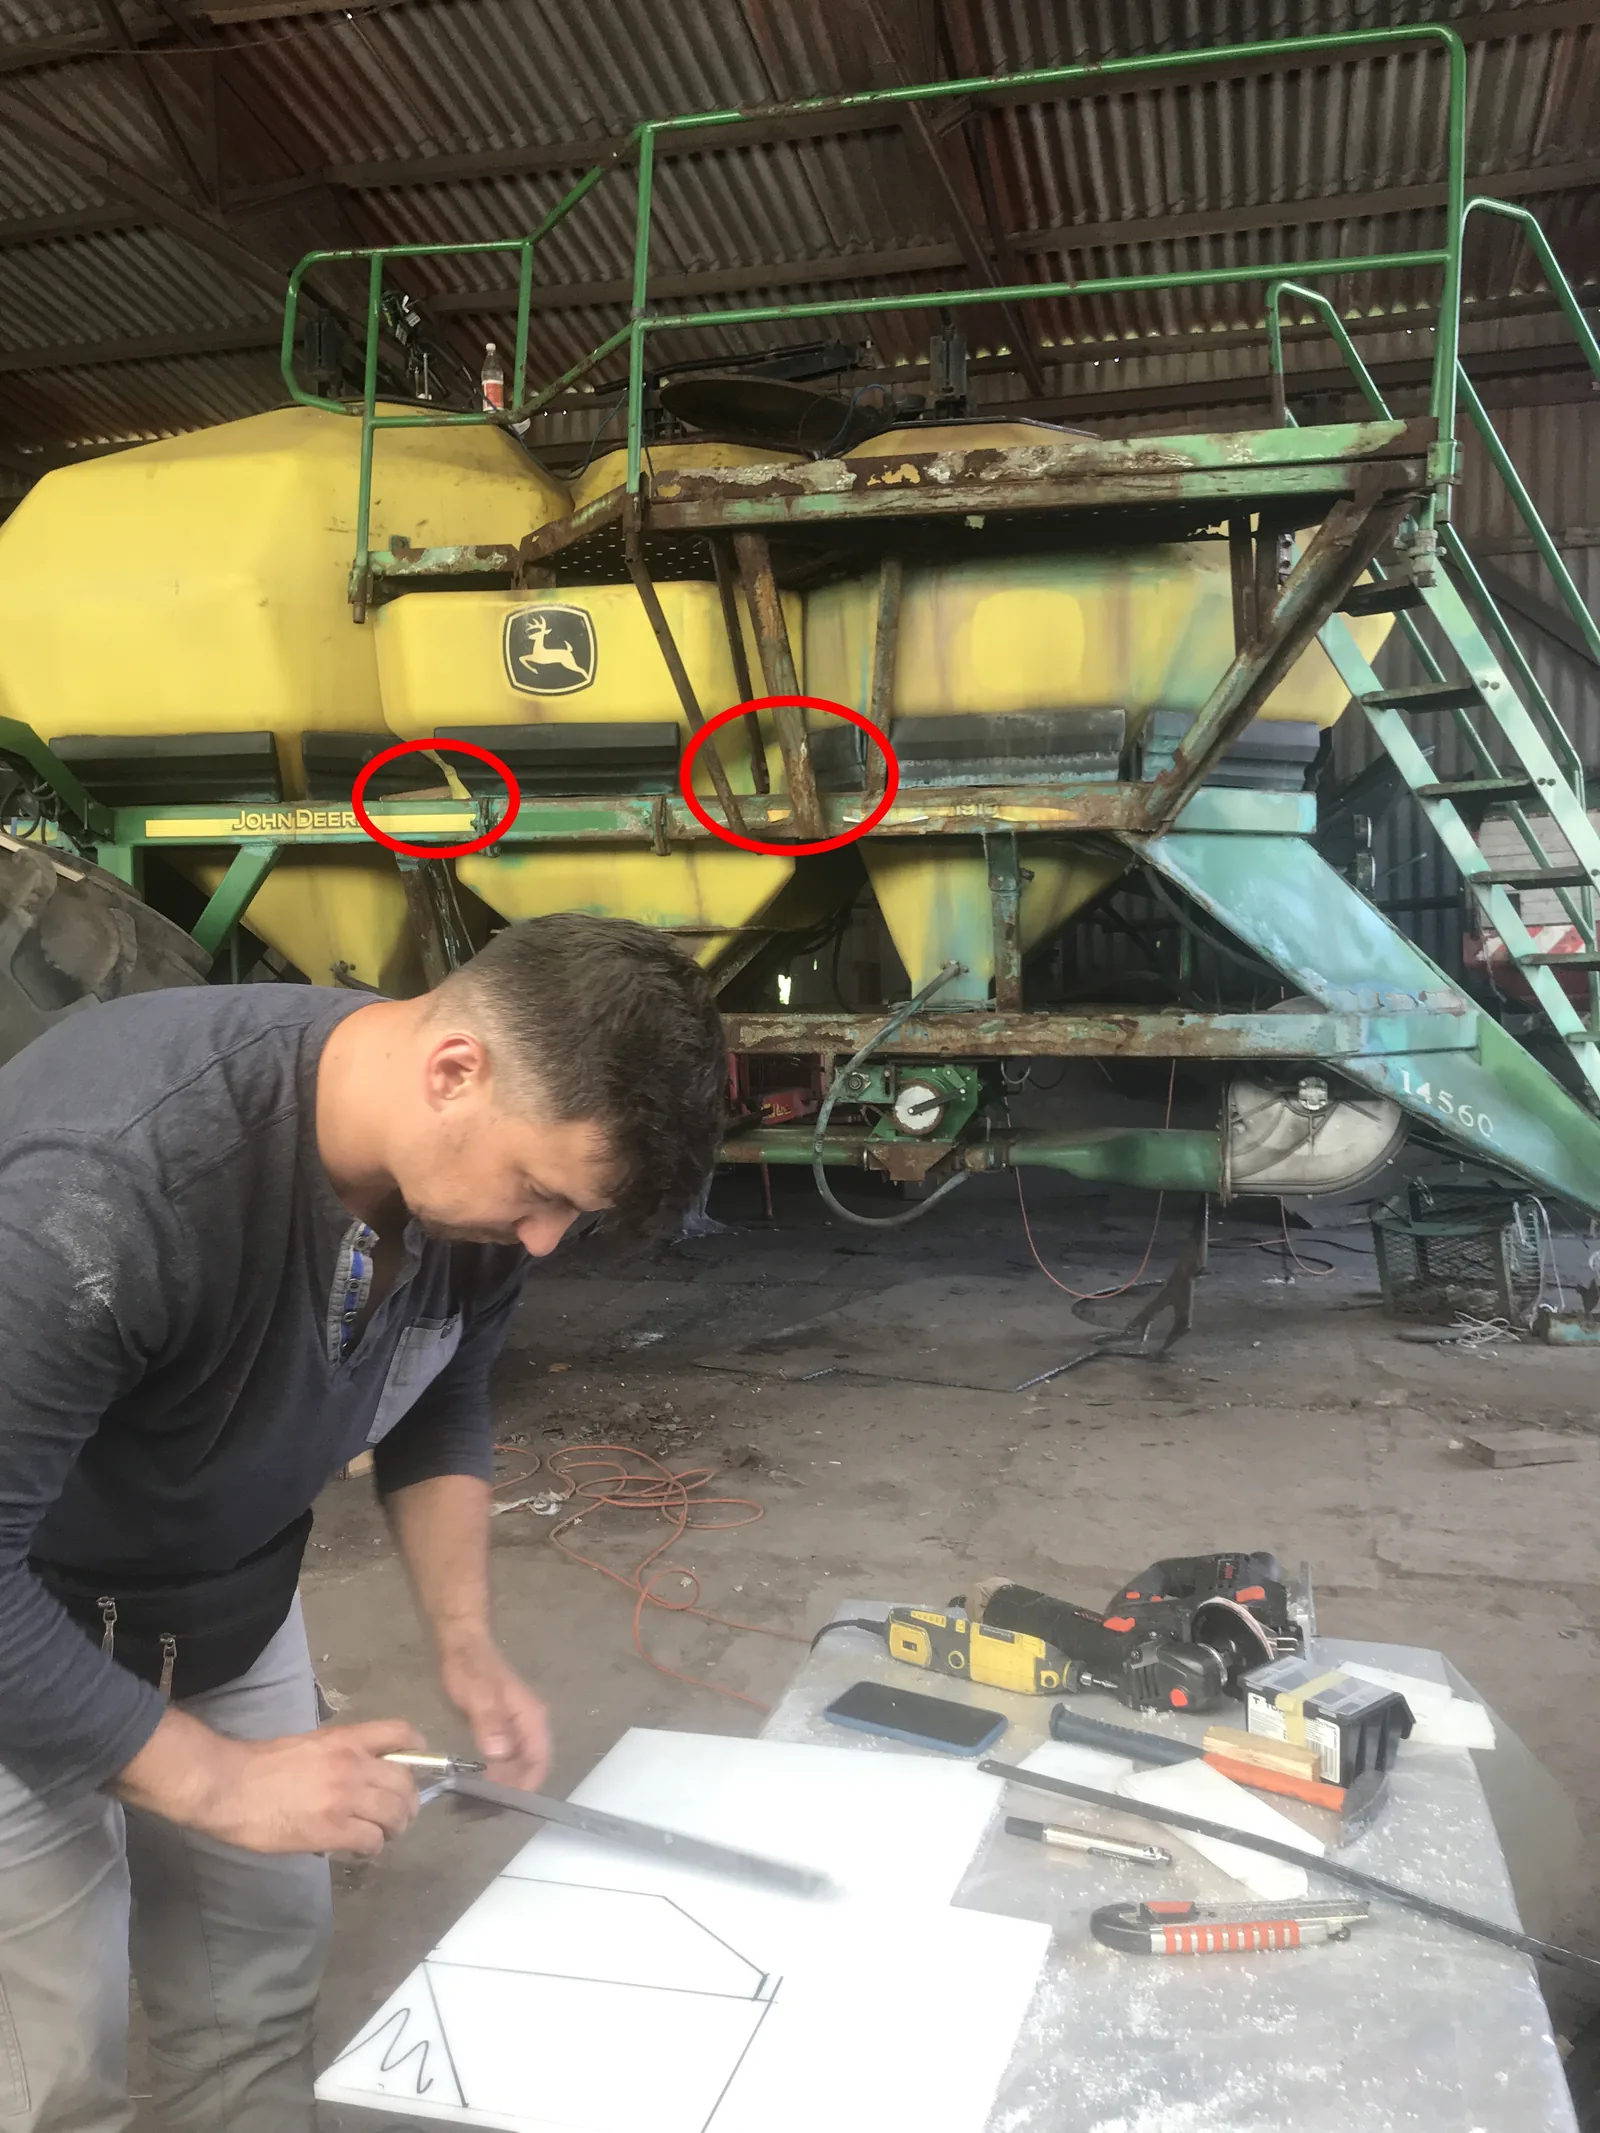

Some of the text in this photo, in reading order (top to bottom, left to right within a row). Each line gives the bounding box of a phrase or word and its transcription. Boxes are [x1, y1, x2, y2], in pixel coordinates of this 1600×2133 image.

[233, 809, 369, 830] JOHN DEER
[1401, 1069, 1494, 1138] 14560
